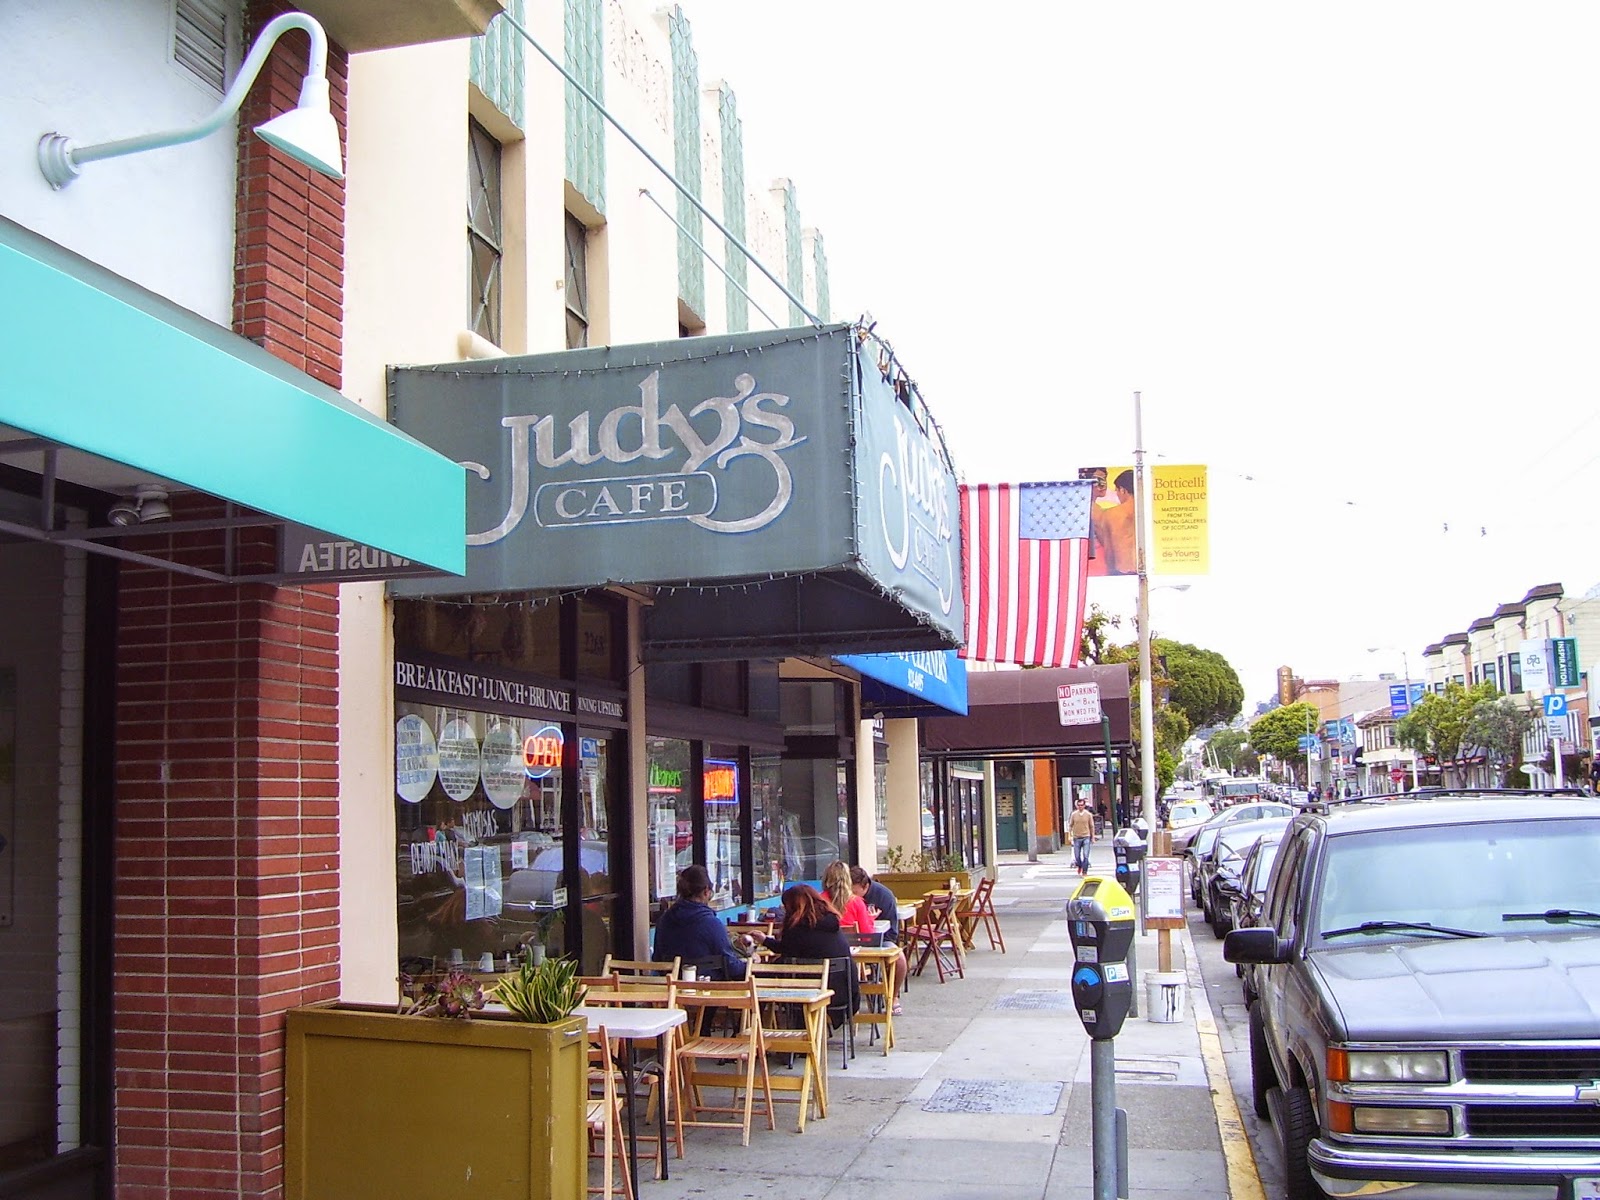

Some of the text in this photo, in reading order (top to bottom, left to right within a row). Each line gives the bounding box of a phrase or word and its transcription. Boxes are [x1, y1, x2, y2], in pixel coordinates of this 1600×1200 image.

[466, 370, 807, 546] Judy's
[1153, 490, 1206, 502] to Braque
[1155, 476, 1205, 488] Botticelli
[554, 480, 690, 519] CAFE
[1174, 550, 1199, 558] Young
[1557, 641, 1568, 686] INSPIRATION
[396, 661, 571, 712] BREAKFAST LUNCH BRUNCH
[1058, 686, 1096, 697] NO PARKING
[597, 699, 624, 718] UPSTAIRS
[523, 736, 563, 768] OPEN
[462, 809, 498, 839] MIMOSAS
